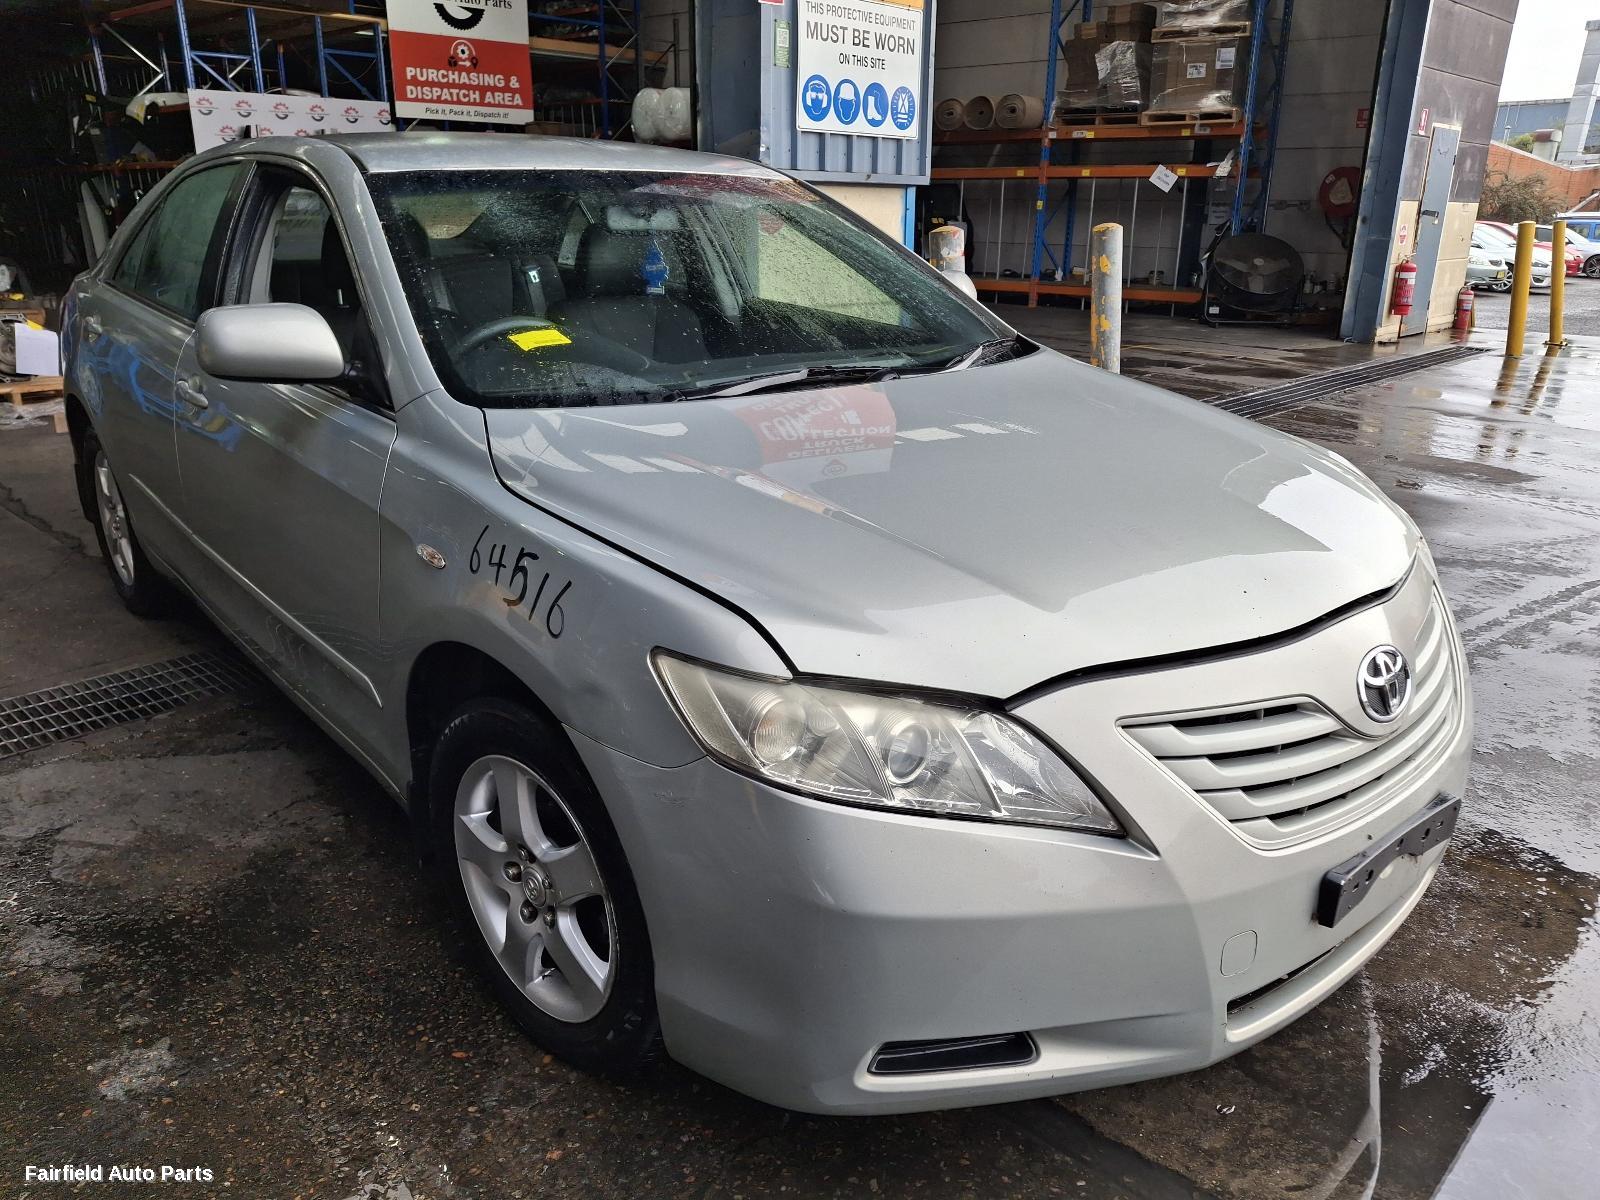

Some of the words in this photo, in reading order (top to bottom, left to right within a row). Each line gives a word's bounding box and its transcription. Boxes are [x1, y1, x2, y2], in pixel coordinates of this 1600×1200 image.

[485, 0, 512, 9] Parts
[806, 0, 824, 15] THIS
[826, 4, 873, 24] PROTECTIVE
[875, 13, 916, 31] EQUIPMENT
[806, 20, 849, 44] MUST
[852, 28, 870, 48] BE
[874, 32, 915, 55] WORN
[839, 53, 850, 65] ON
[852, 55, 868, 68] THIS
[870, 57, 886, 70] SITE
[406, 67, 505, 88] PURCHASING
[509, 76, 520, 89] &
[406, 85, 480, 103] DISPATCH
[484, 91, 523, 106] AREA
[425, 107, 439, 115] Pick
[449, 108, 464, 116] Pack
[474, 110, 501, 119] Dispatch
[470, 524, 572, 639] 64516
